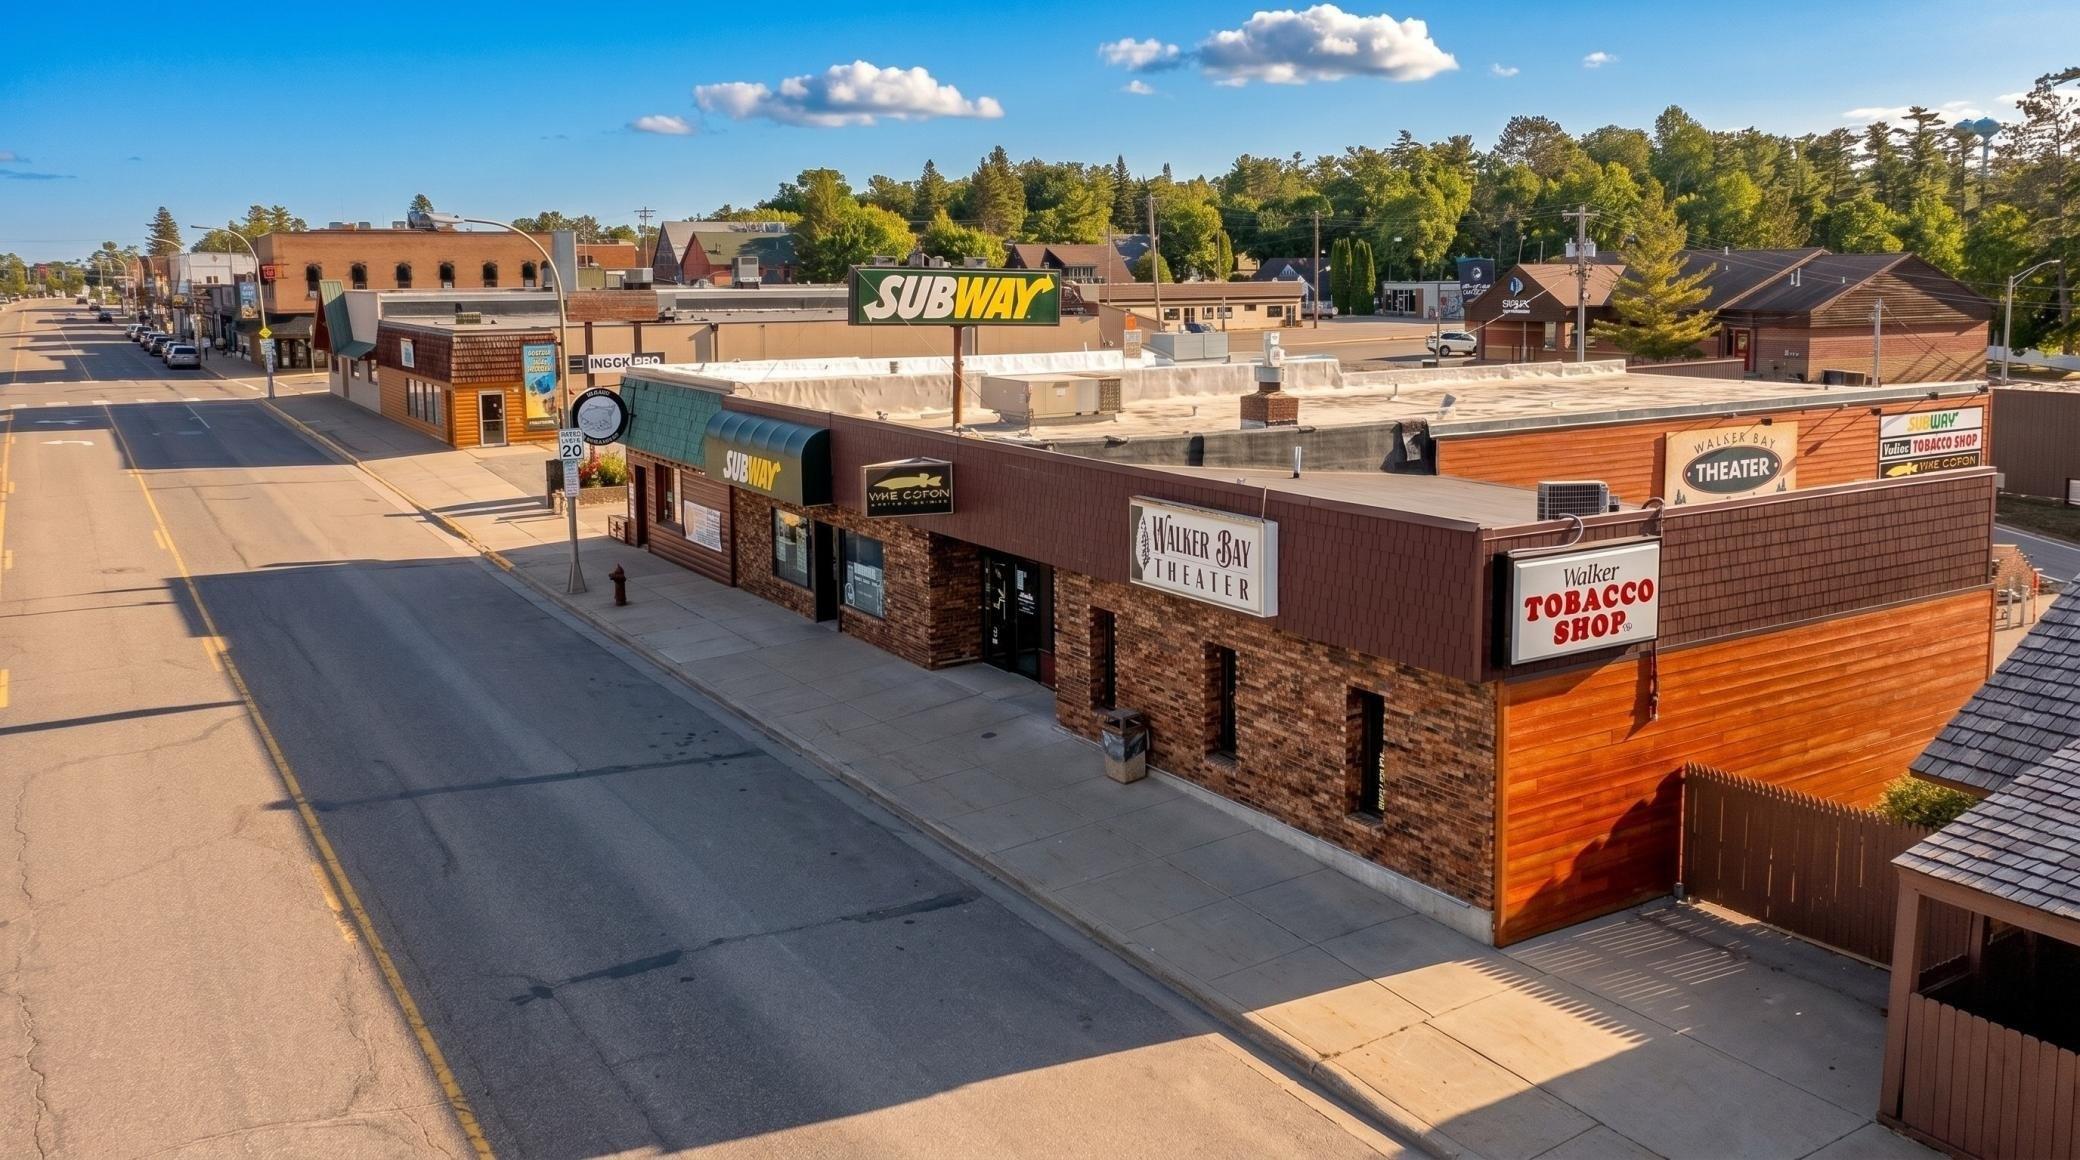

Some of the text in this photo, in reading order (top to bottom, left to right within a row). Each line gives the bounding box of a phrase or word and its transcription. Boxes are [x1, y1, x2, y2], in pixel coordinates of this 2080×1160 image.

[863, 274, 1054, 322] SUBWAY
[590, 358, 630, 369] INGGK
[1907, 412, 1959, 432] SUBWAY
[563, 445, 581, 457] 20
[1694, 432, 1776, 454] WALKER BAY
[1913, 437, 1952, 453] TOBACCO
[1954, 433, 1977, 448] SHOP
[723, 450, 781, 491] SUBWAY
[1696, 457, 1770, 482] THEATER
[1153, 514, 1251, 568] WALKER BAY
[1154, 558, 1249, 601] THEATER
[1563, 563, 1620, 588] Walker
[1525, 578, 1654, 622] TOBACCO
[1554, 610, 1626, 645] SHOP
